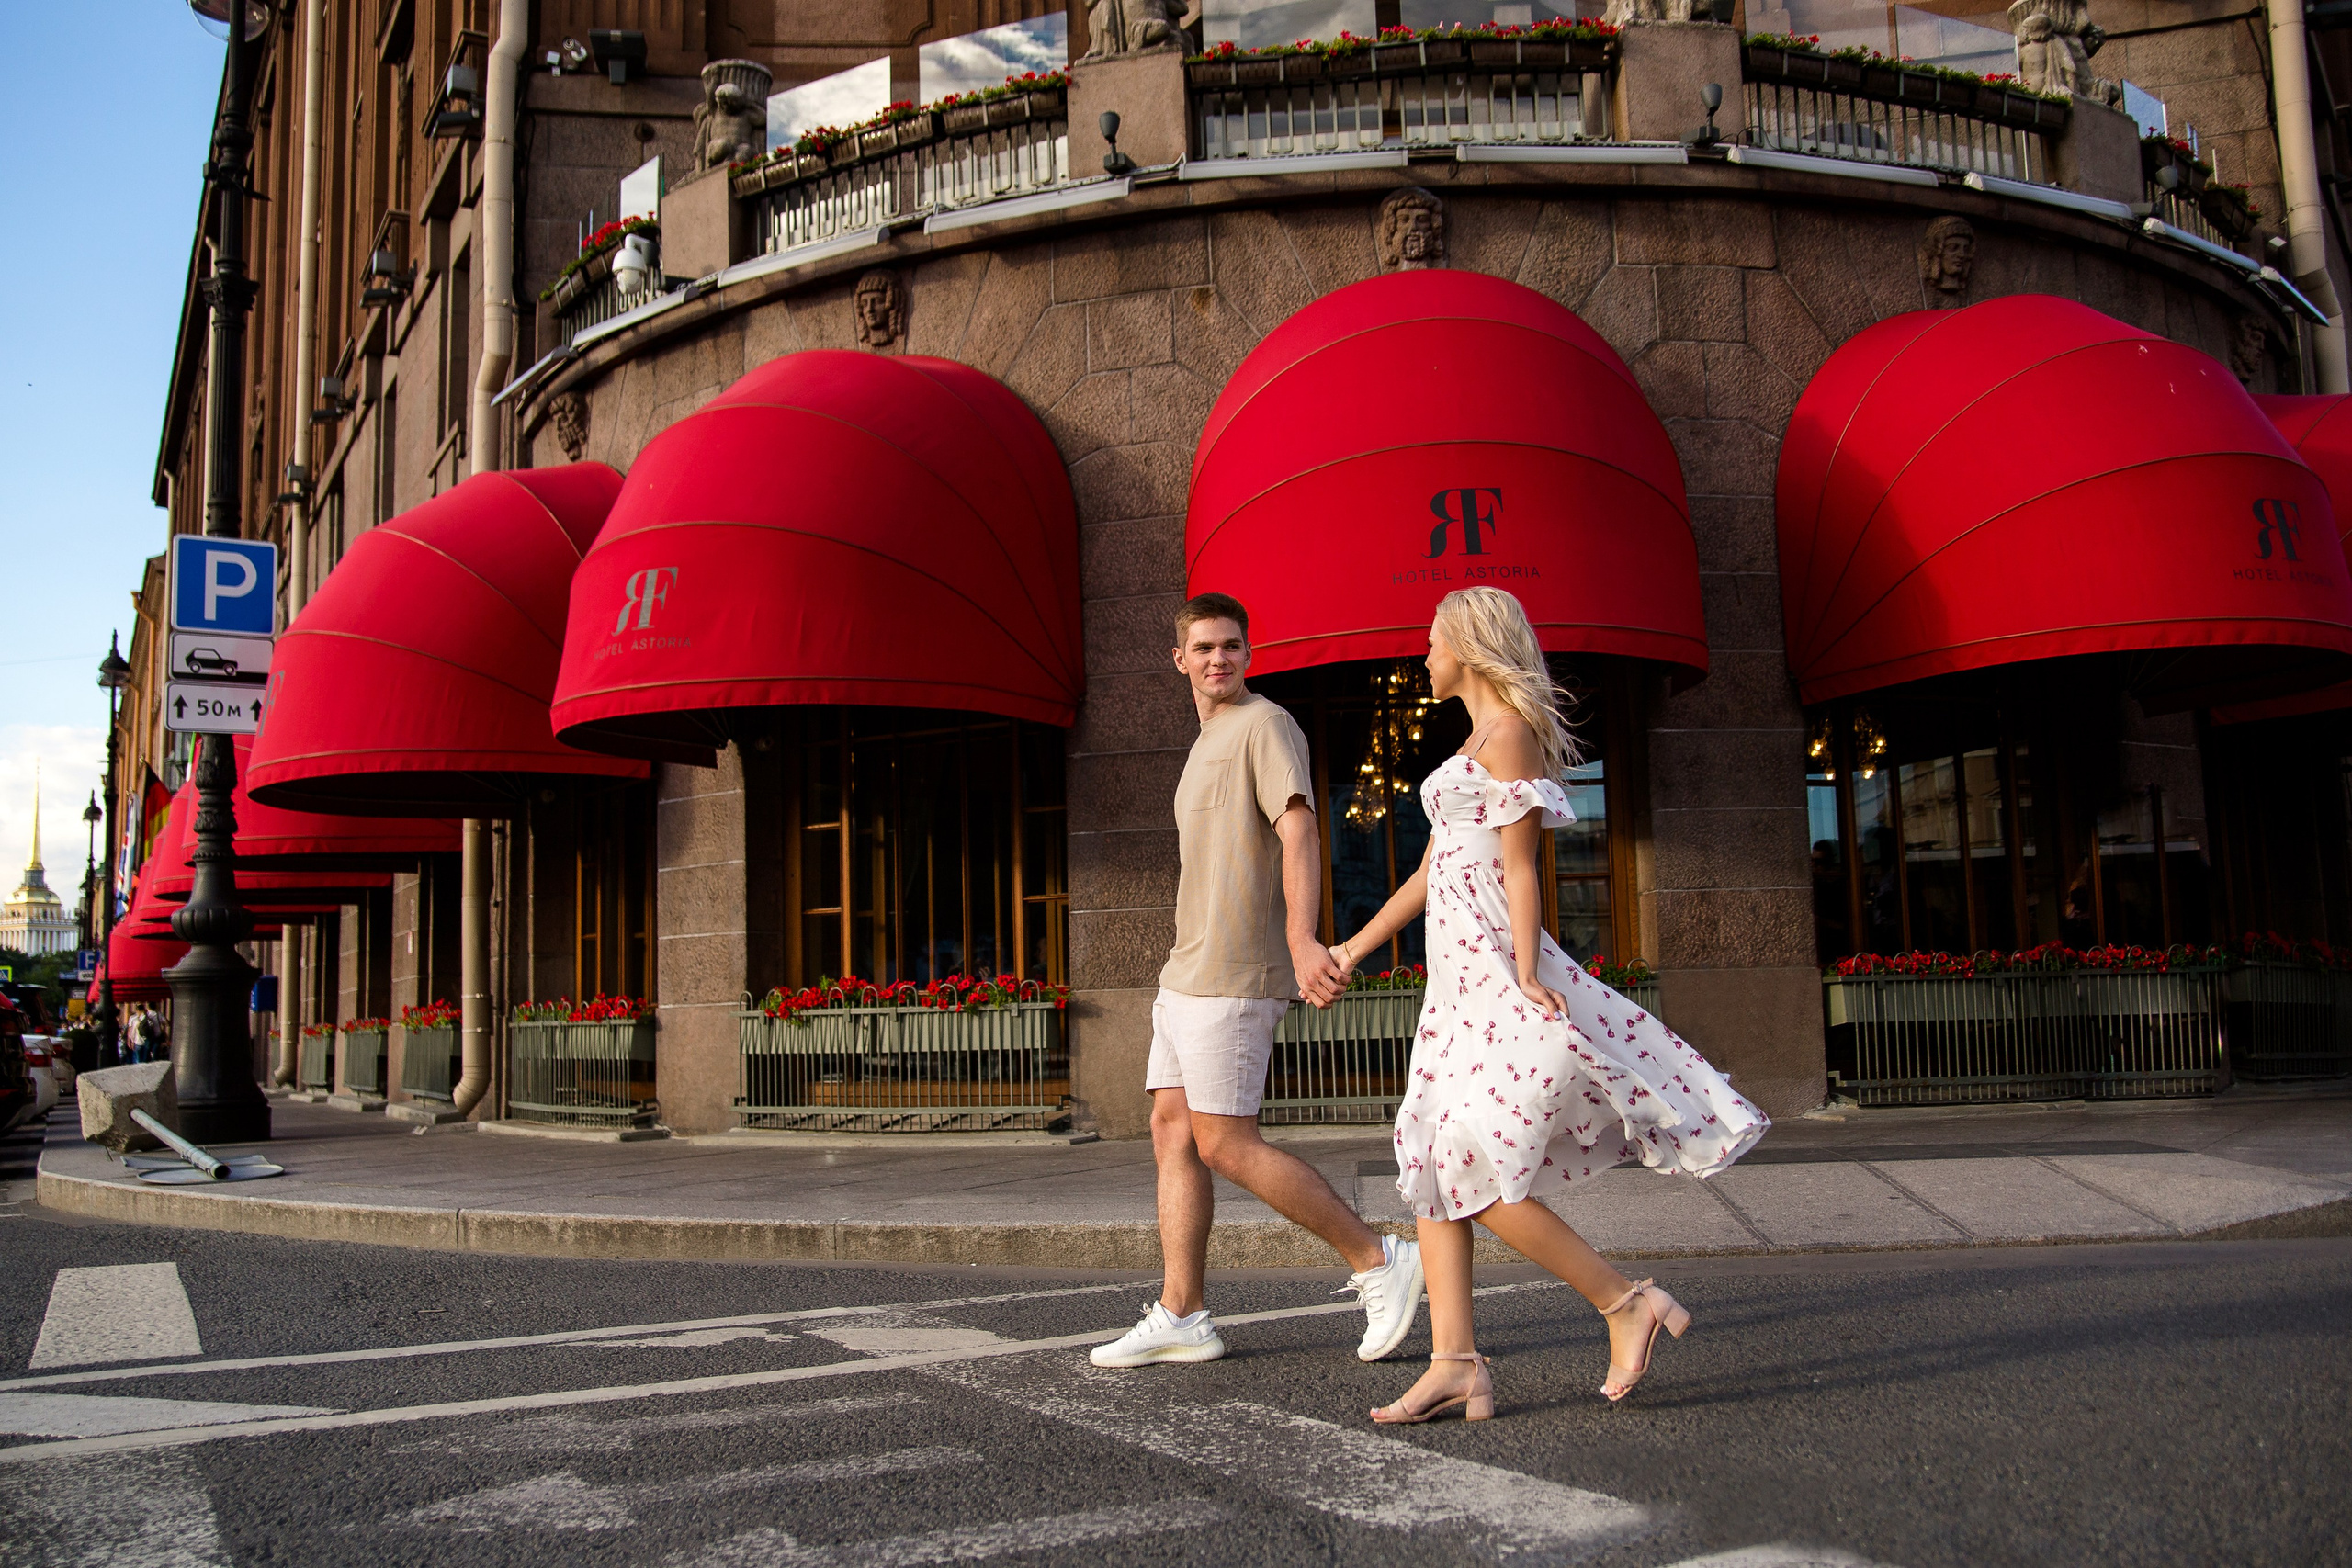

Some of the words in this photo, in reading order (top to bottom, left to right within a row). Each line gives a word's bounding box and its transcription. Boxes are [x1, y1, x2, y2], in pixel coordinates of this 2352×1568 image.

[204, 549, 257, 621] P
[1393, 568, 1453, 585] HOTEL
[1464, 565, 1541, 579] ASTORIA
[2233, 568, 2282, 581] HOTEL
[593, 642, 624, 660] HOTEL
[630, 637, 691, 651] ASTORIA
